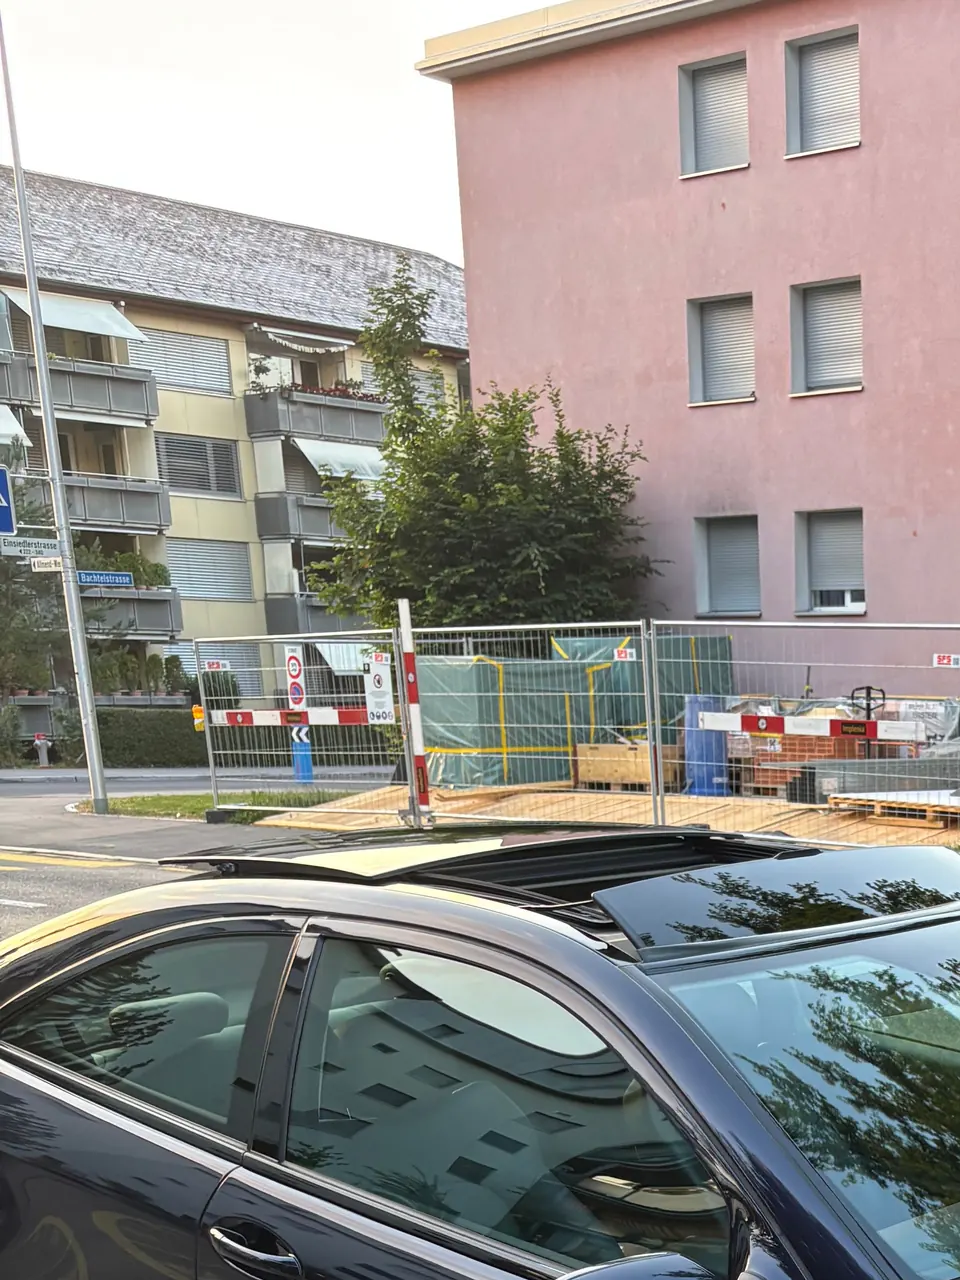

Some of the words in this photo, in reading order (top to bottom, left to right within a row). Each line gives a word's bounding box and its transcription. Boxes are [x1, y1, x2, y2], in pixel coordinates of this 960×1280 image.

[3, 538, 57, 550] Einsiedlerstrasse
[80, 573, 130, 584] Bachtelstrasse
[937, 655, 951, 665] SFS
